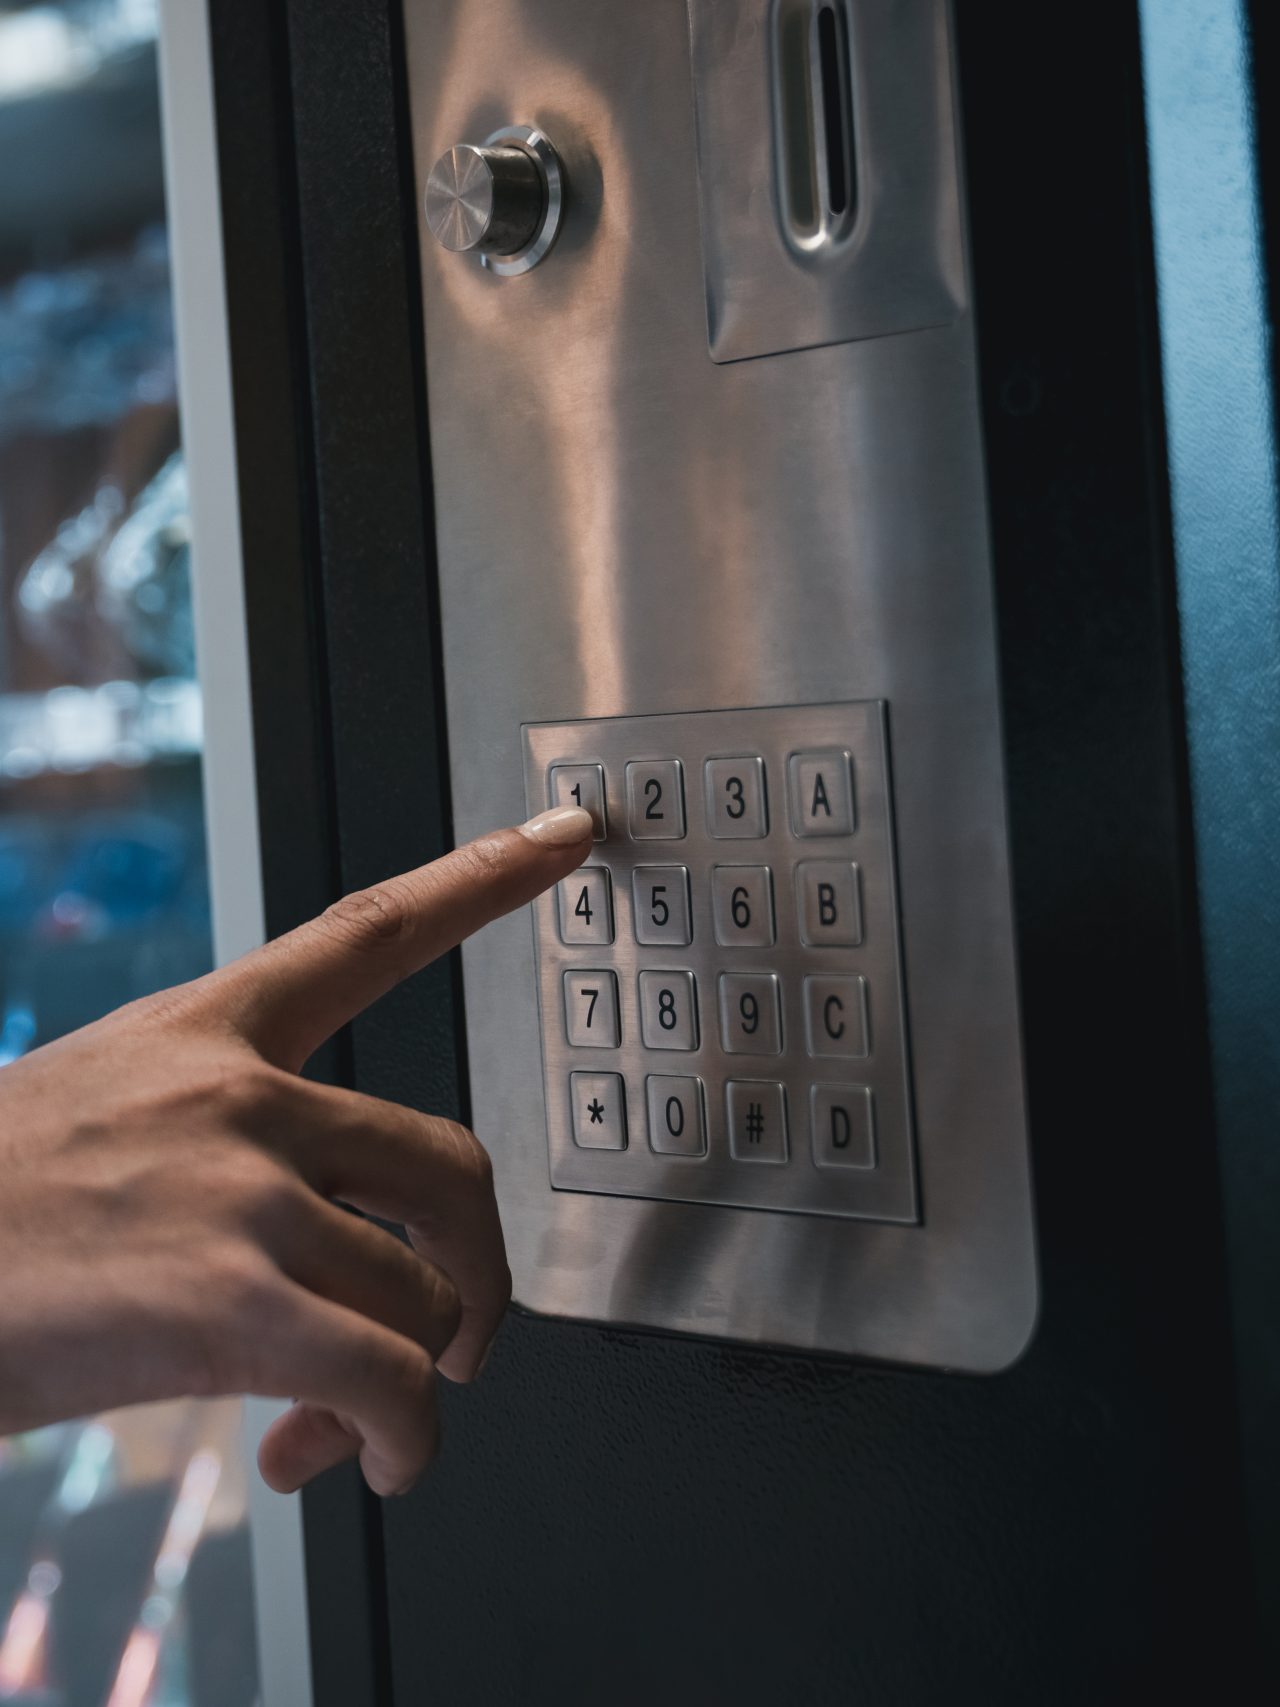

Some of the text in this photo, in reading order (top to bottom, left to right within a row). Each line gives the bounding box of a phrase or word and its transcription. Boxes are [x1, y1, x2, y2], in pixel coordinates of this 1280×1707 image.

[570, 772, 832, 820] 1 2 3 A
[574, 882, 837, 928] 4 5 6 B
[580, 988, 845, 1040] 7 8 9 C
[665, 1096, 684, 1138] 0
[745, 1102, 765, 1144] #
[830, 1105, 851, 1149] D
